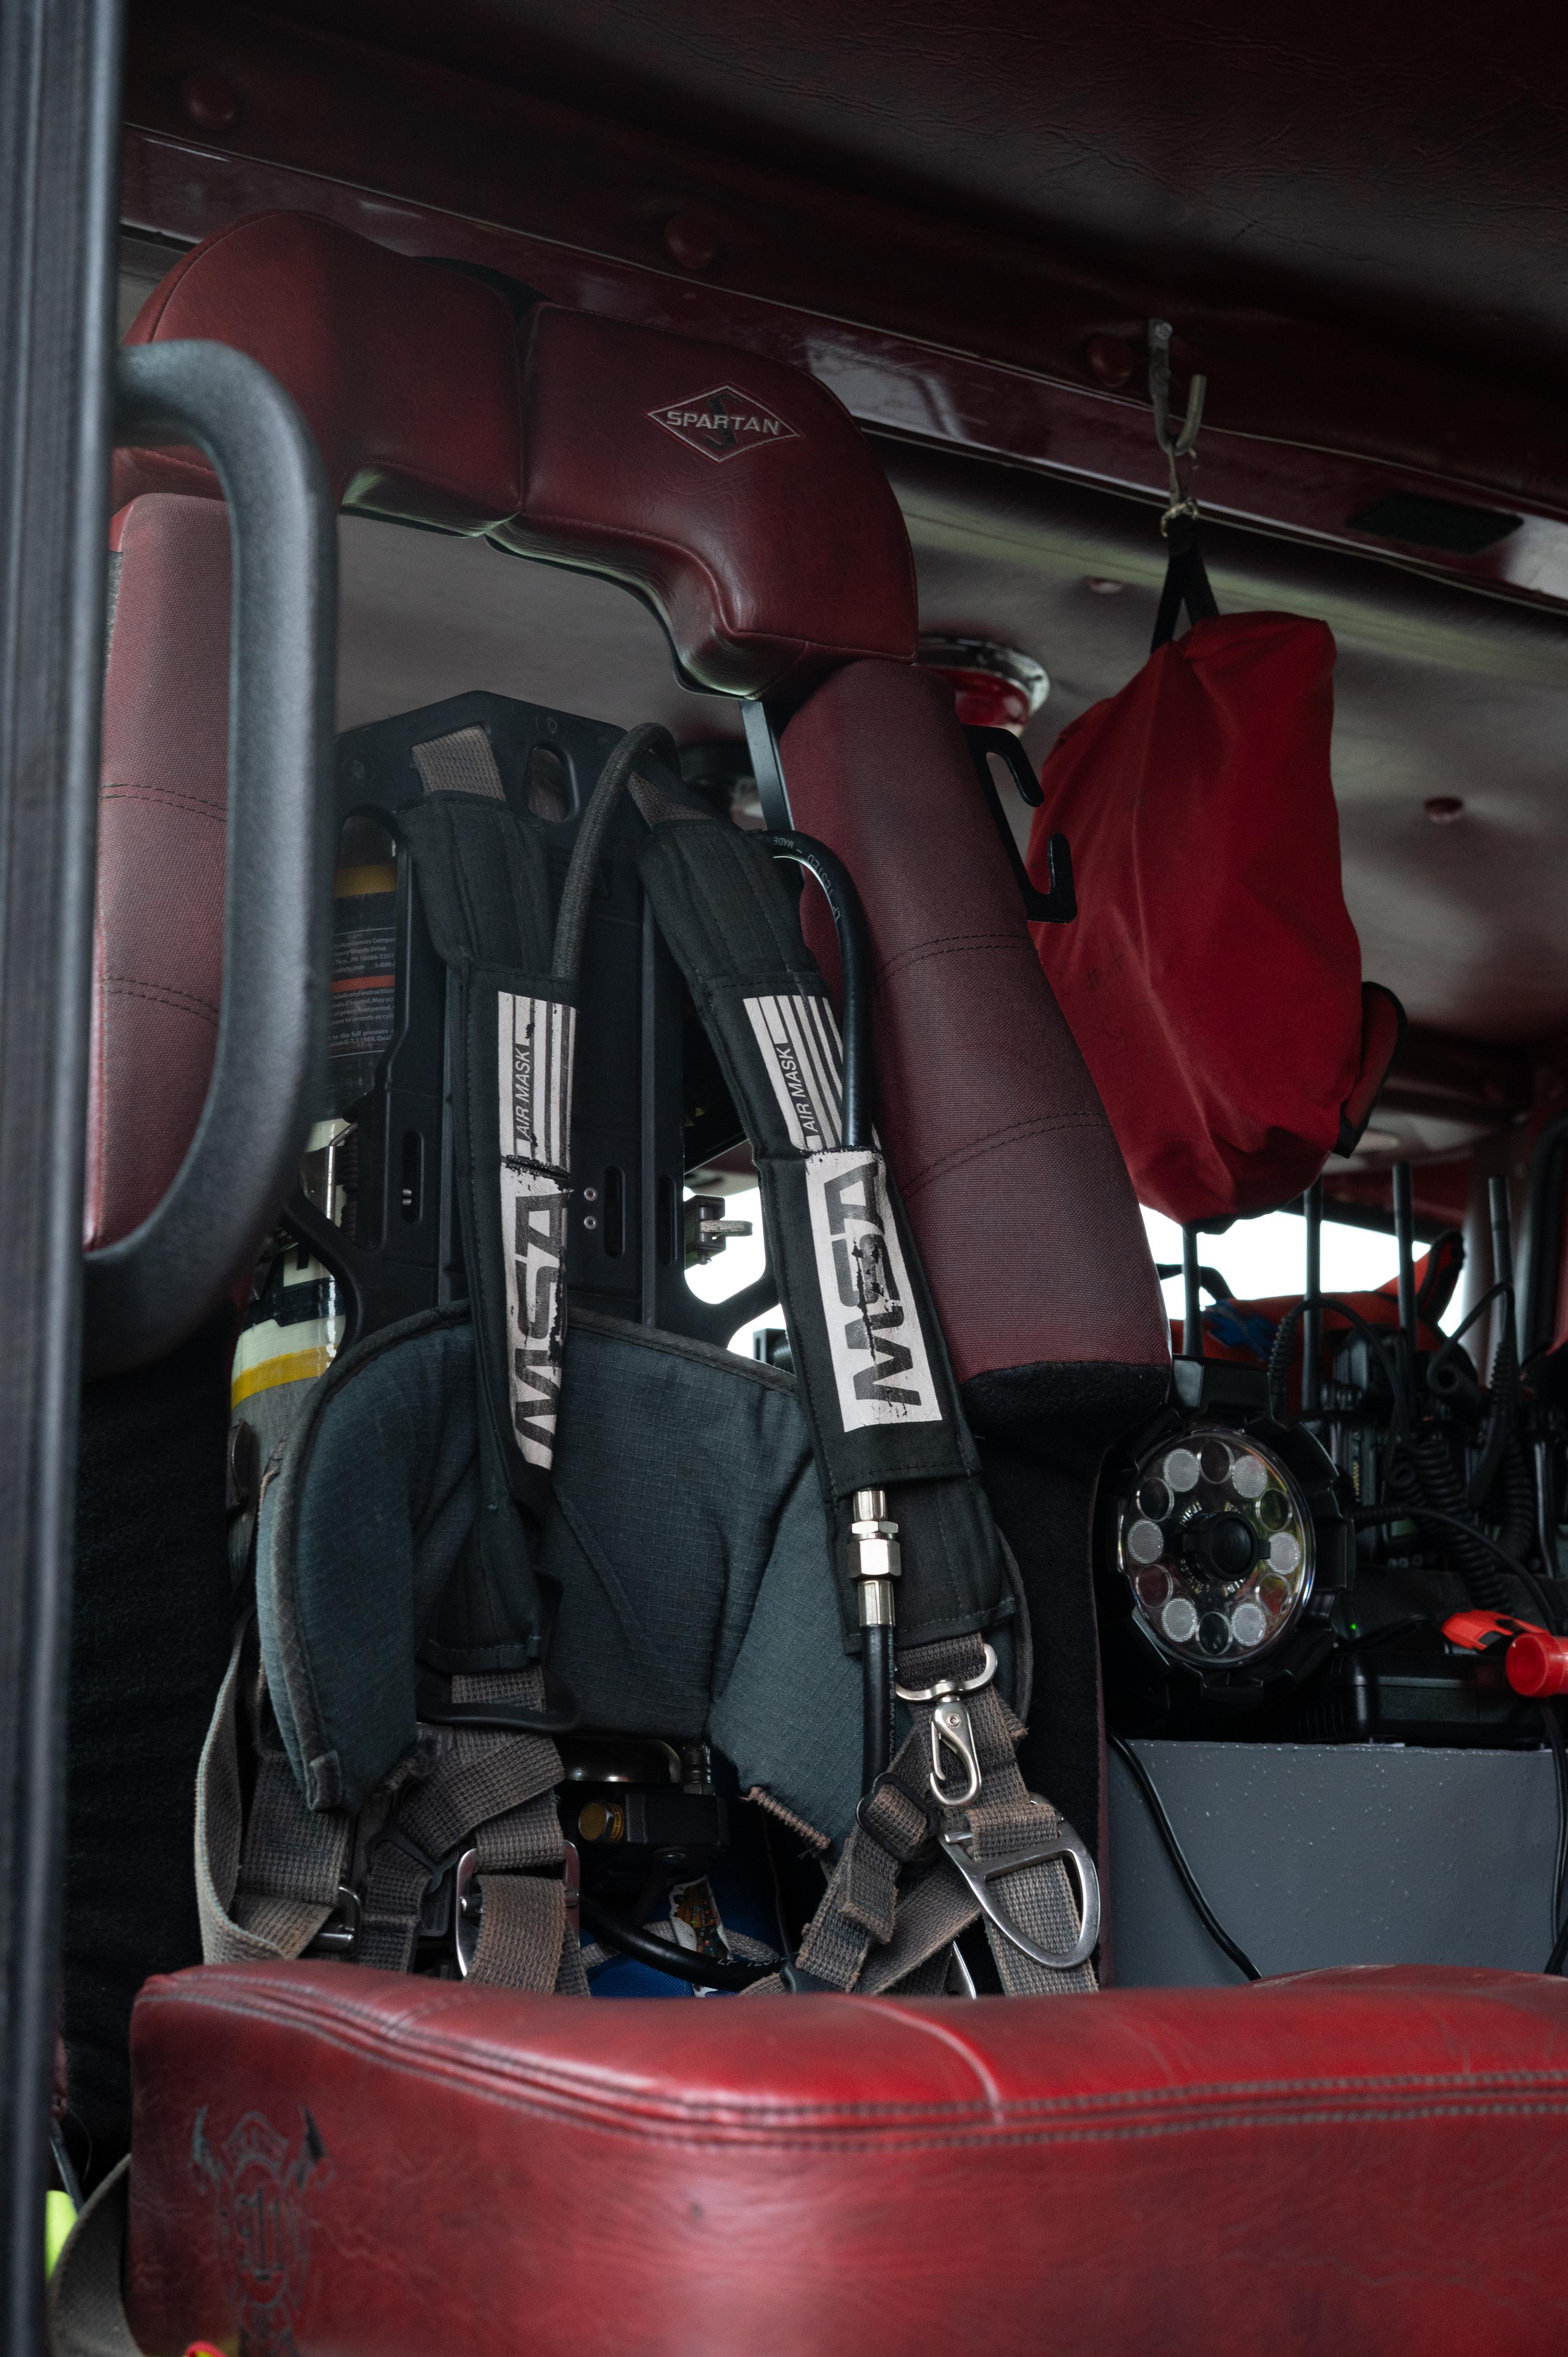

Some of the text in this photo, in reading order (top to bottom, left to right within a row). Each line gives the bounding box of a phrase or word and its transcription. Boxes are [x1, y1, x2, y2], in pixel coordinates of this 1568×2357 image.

[665, 411, 780, 435] SPARTAN
[773, 837, 794, 849] MADE
[515, 1047, 532, 1142] AIR MASK
[776, 1047, 819, 1133] AIR MASK
[823, 1160, 922, 1406] MSA
